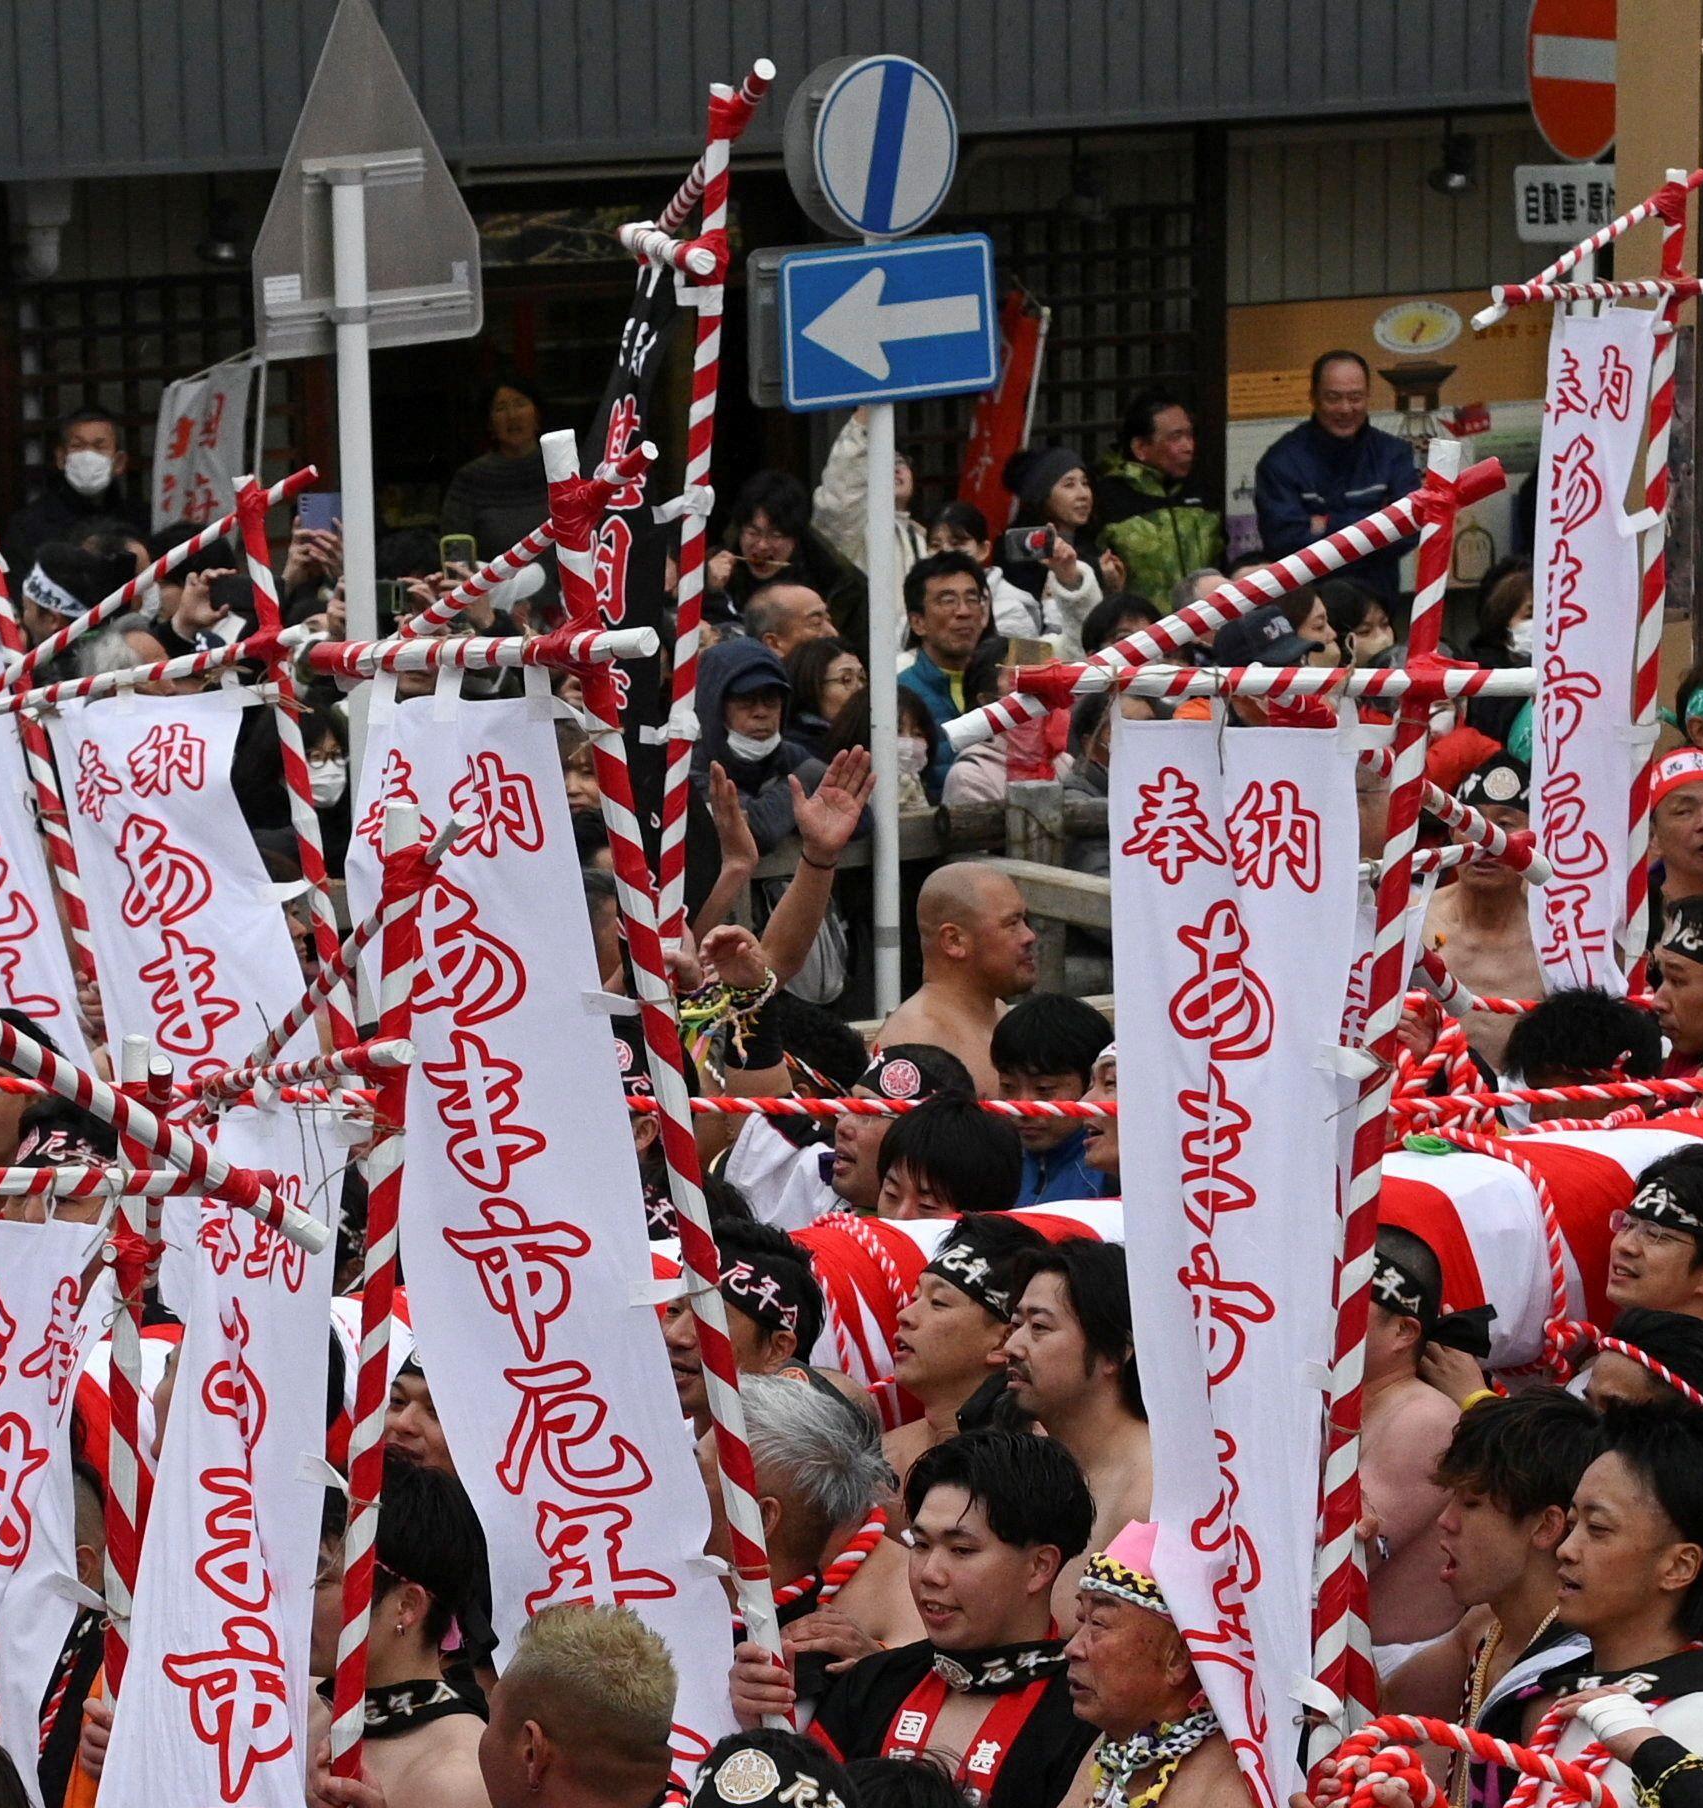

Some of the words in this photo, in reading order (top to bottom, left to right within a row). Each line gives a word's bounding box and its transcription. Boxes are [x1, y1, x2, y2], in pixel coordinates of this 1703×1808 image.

[74, 723, 206, 822] 奉納
[356, 747, 545, 860] 奉納
[1122, 766, 1322, 894] 奉納
[113, 813, 241, 1125] あま
[413, 872, 710, 1790] あま市厄年
